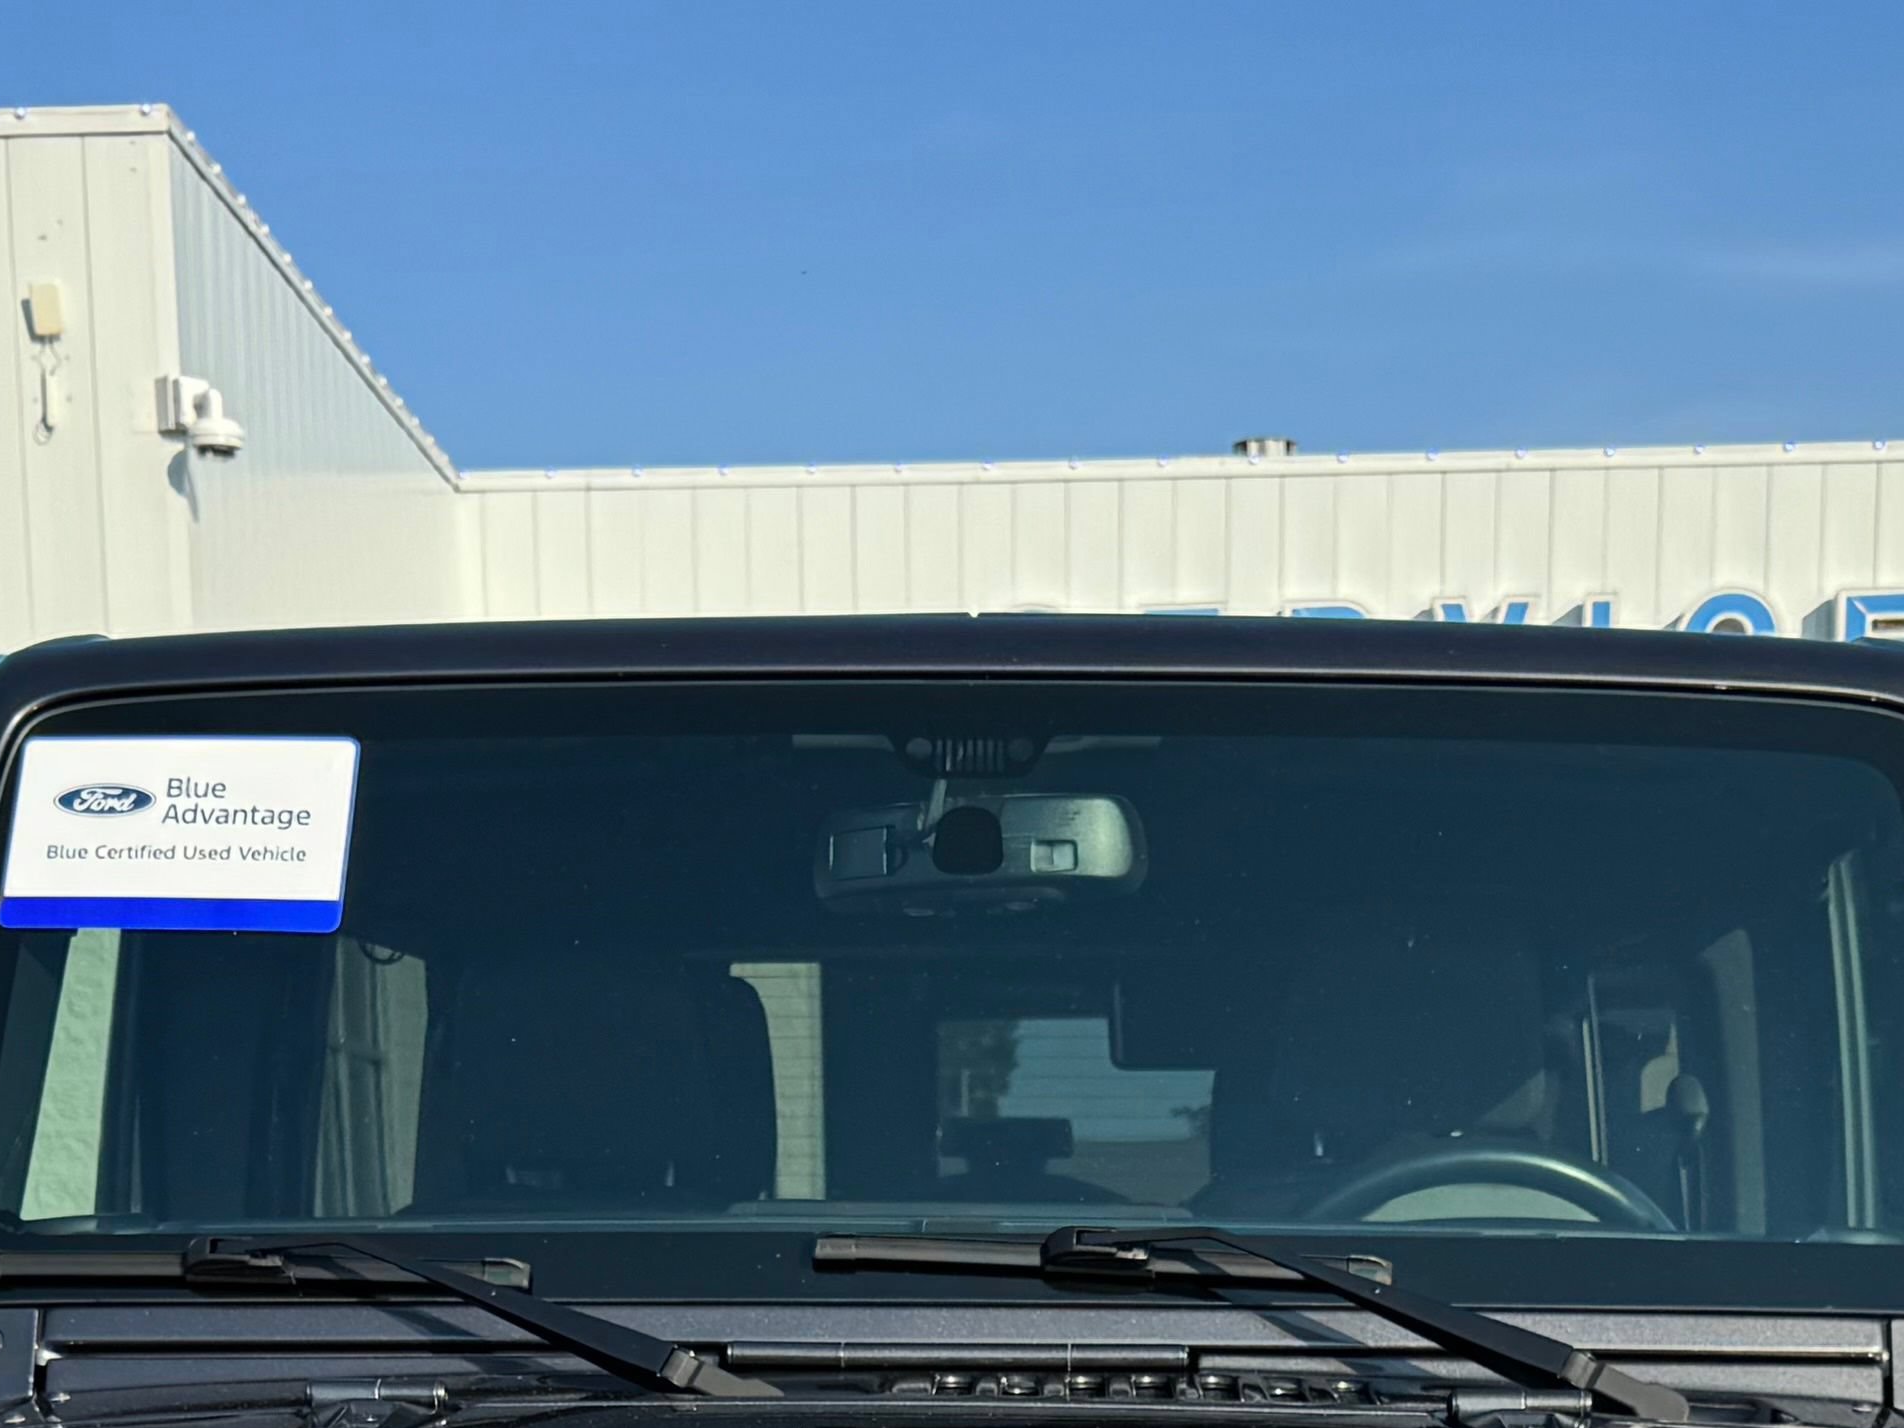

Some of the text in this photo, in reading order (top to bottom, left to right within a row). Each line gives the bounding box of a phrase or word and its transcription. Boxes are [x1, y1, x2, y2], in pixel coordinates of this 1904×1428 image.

[166, 778, 227, 799] Blue
[160, 803, 312, 830] Advantage
[46, 844, 307, 864] Blue Certified Used Vehicle
